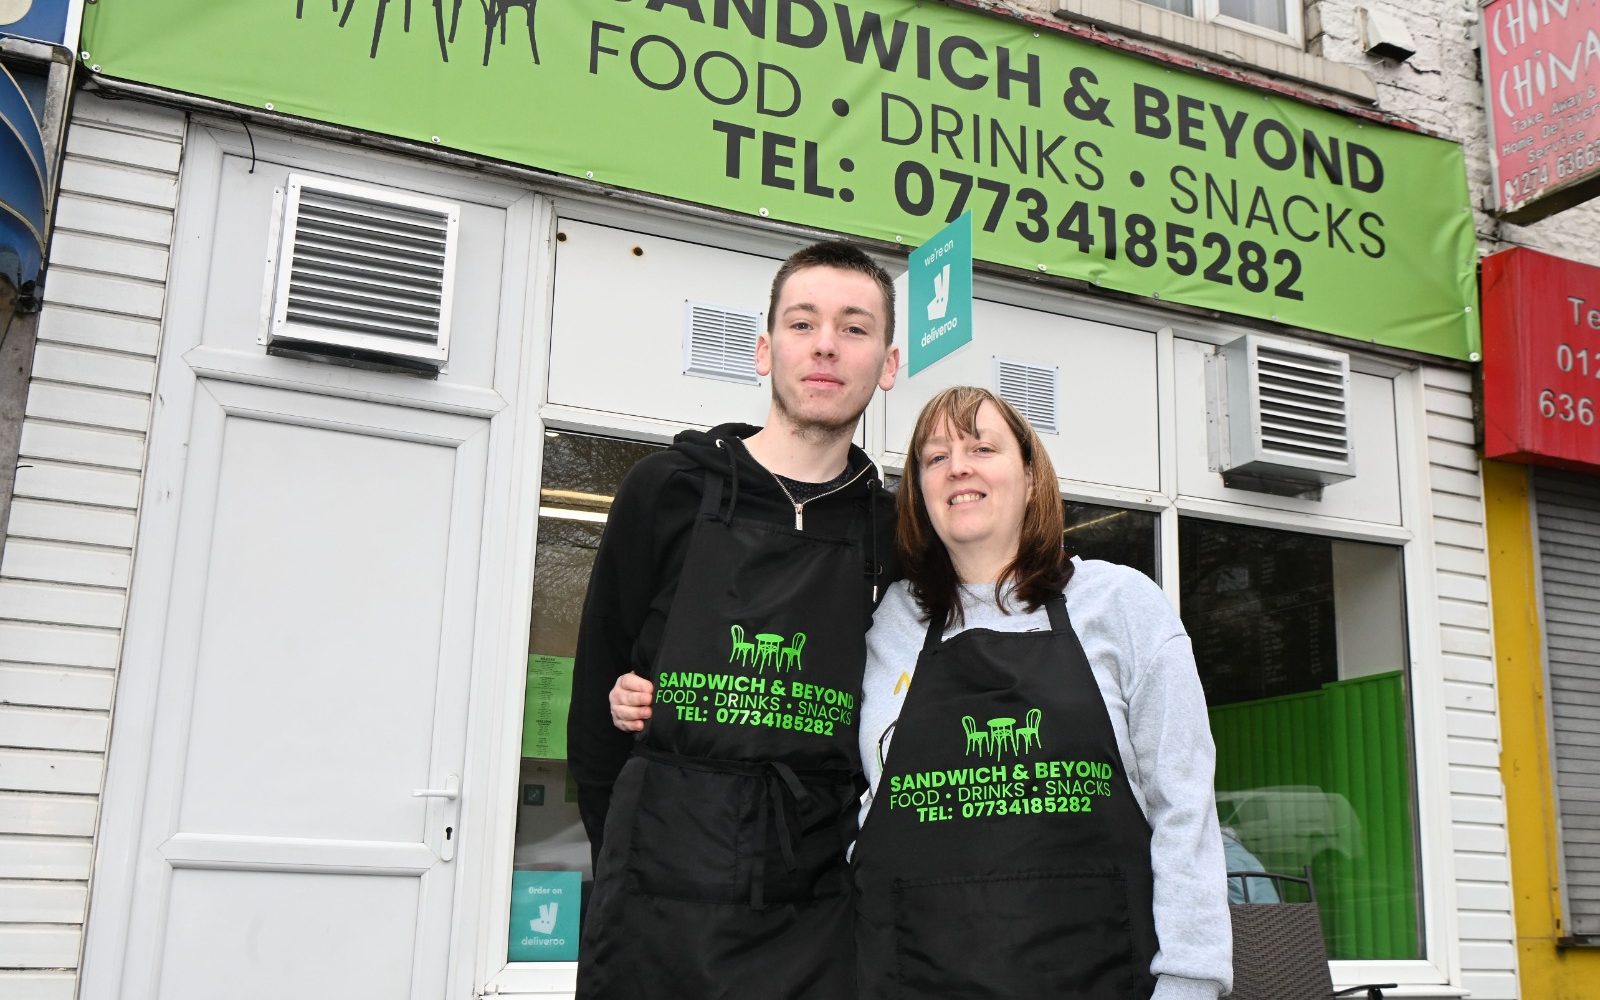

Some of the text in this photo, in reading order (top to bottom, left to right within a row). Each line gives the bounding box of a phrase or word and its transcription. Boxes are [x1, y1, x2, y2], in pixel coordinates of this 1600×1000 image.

[613, 0, 1385, 194] NDWICH & BEYOND
[1511, 85, 1597, 134] Take Away &
[589, 20, 1386, 259] FOOD DRINKS SNACKS
[1503, 136, 1534, 156] Home
[1528, 130, 1585, 163] Service
[712, 120, 1304, 301] TEL: 07734185282
[924, 239, 954, 267] we're on
[921, 317, 958, 348] deliveroo
[1538, 390, 1595, 426] 636
[659, 672, 854, 710] SANDWICH & BEYOND
[655, 690, 852, 726] FOOD DRINKS SNACKS
[676, 706, 834, 736] TEL: 07734185282
[890, 761, 1113, 793] SANDWICH & BEYOND
[890, 779, 1111, 810] FOOD DRINKS SNACKS
[916, 797, 1092, 822] TEL: 07734185282
[528, 886, 550, 895] Order
[521, 936, 565, 946] deliveroo
